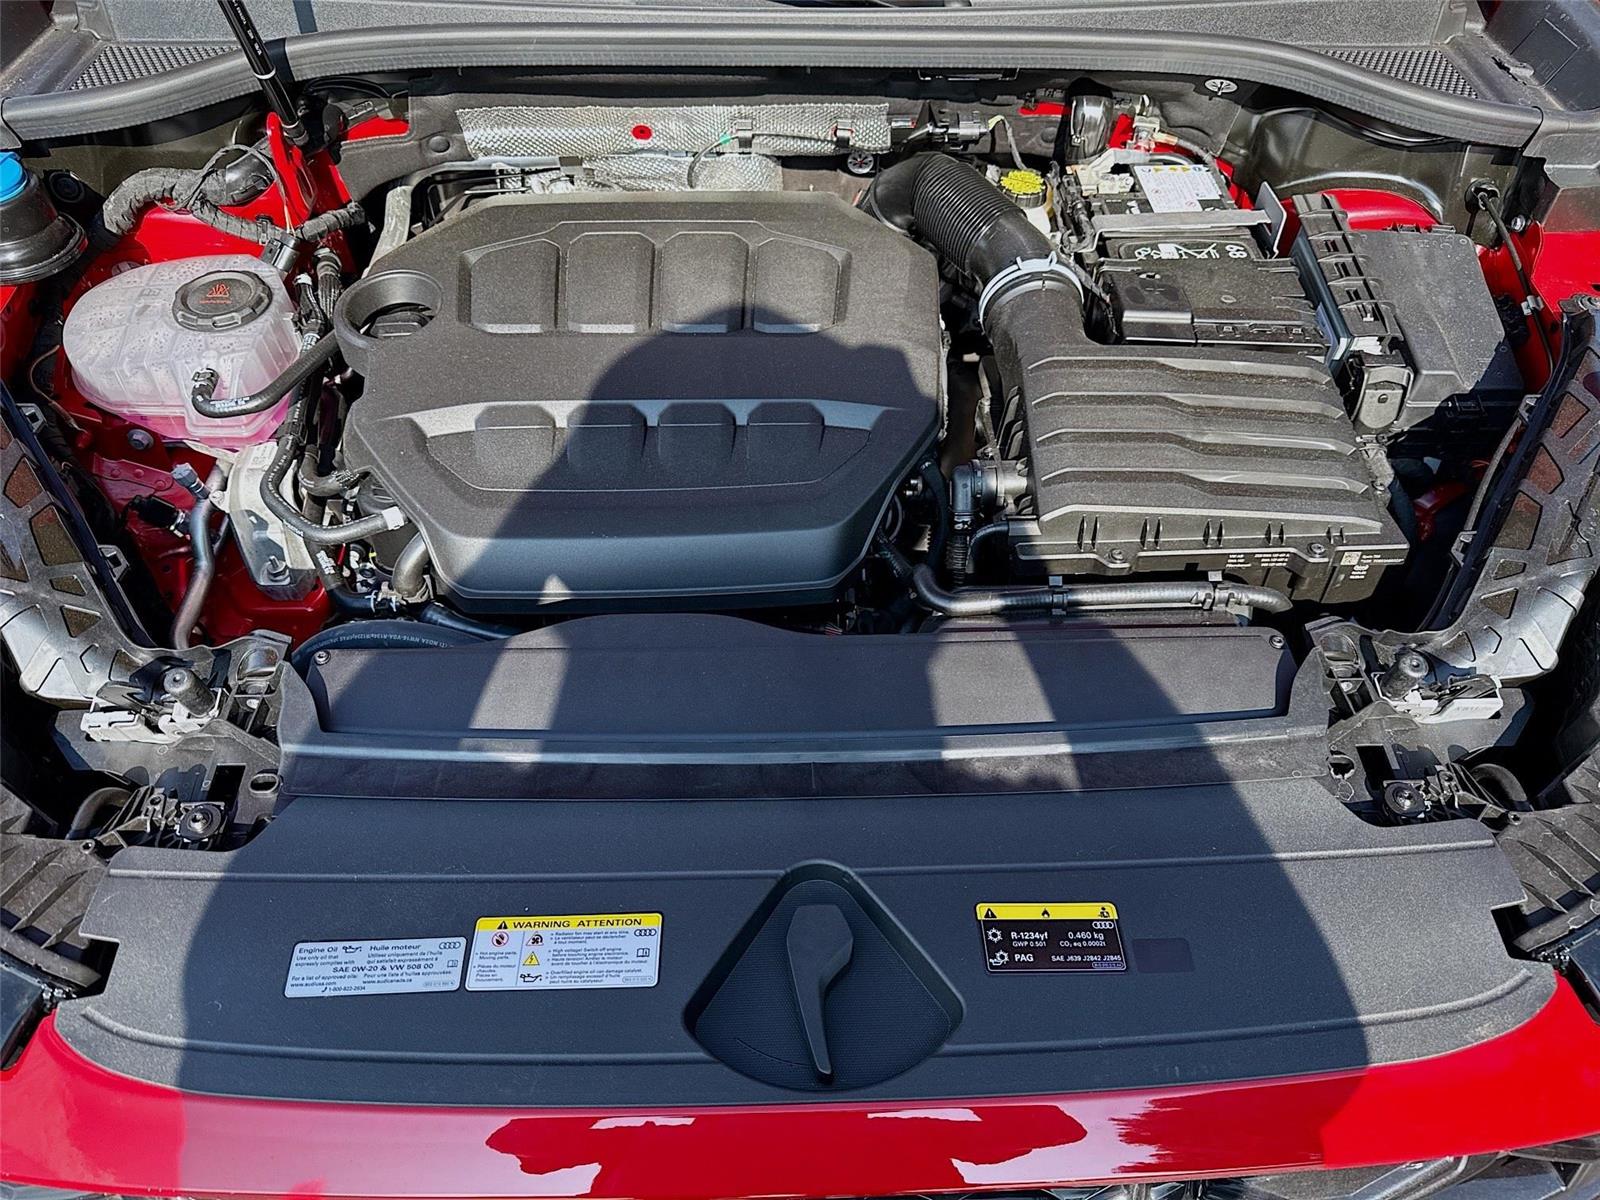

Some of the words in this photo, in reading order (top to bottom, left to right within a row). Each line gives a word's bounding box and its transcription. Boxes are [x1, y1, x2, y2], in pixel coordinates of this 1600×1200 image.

[577, 919, 642, 927] ATTENTION
[1011, 931, 1048, 941] R-1234yf
[1068, 931, 1091, 939] 0.460
[1093, 931, 1105, 941] kg
[1014, 954, 1034, 962] PAG
